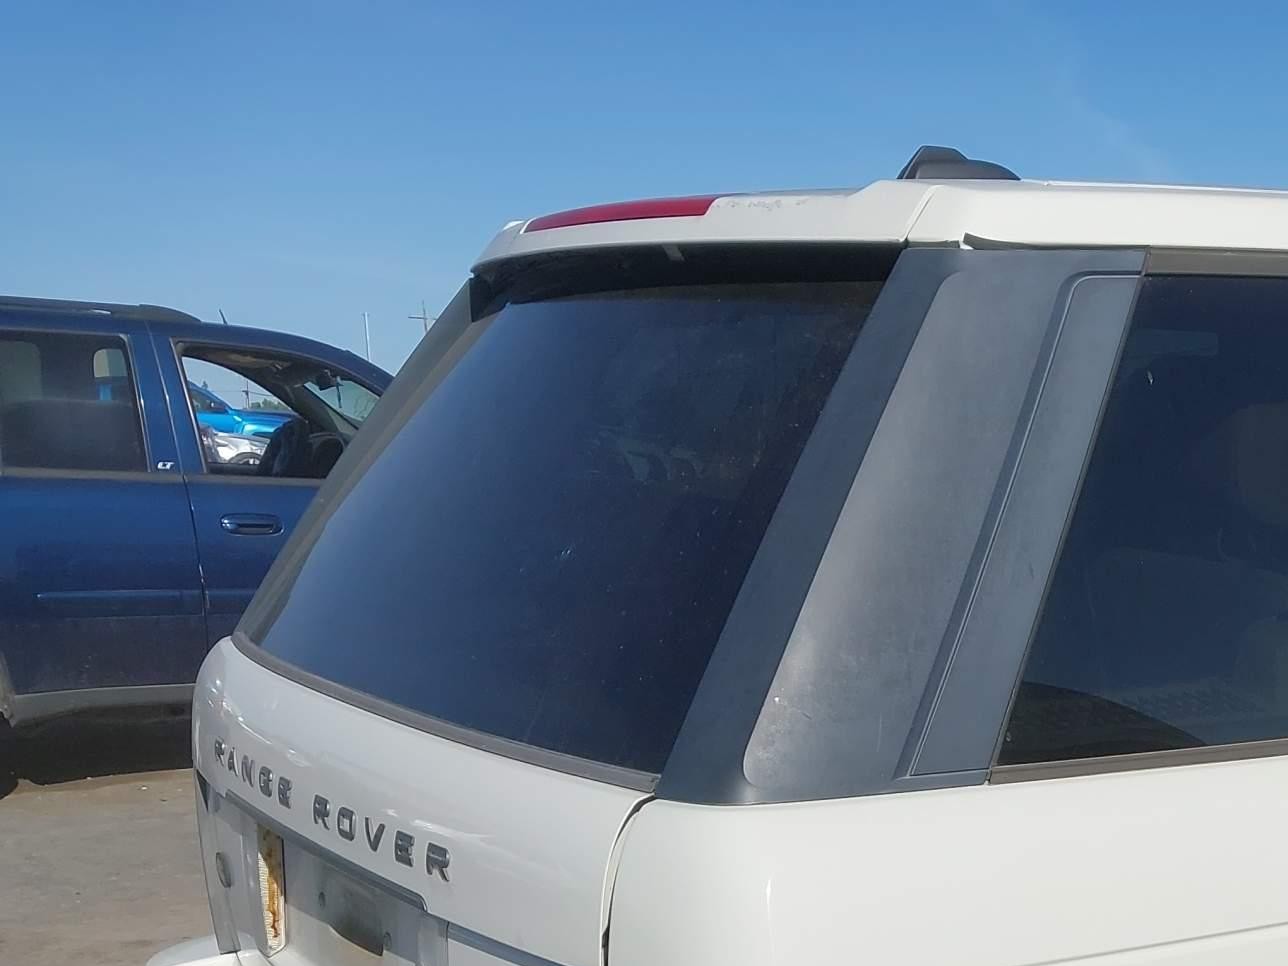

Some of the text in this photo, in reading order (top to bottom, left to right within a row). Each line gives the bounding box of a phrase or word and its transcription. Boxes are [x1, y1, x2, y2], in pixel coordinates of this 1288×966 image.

[157, 461, 175, 470] LT
[215, 737, 450, 882] RANGE ROVER
